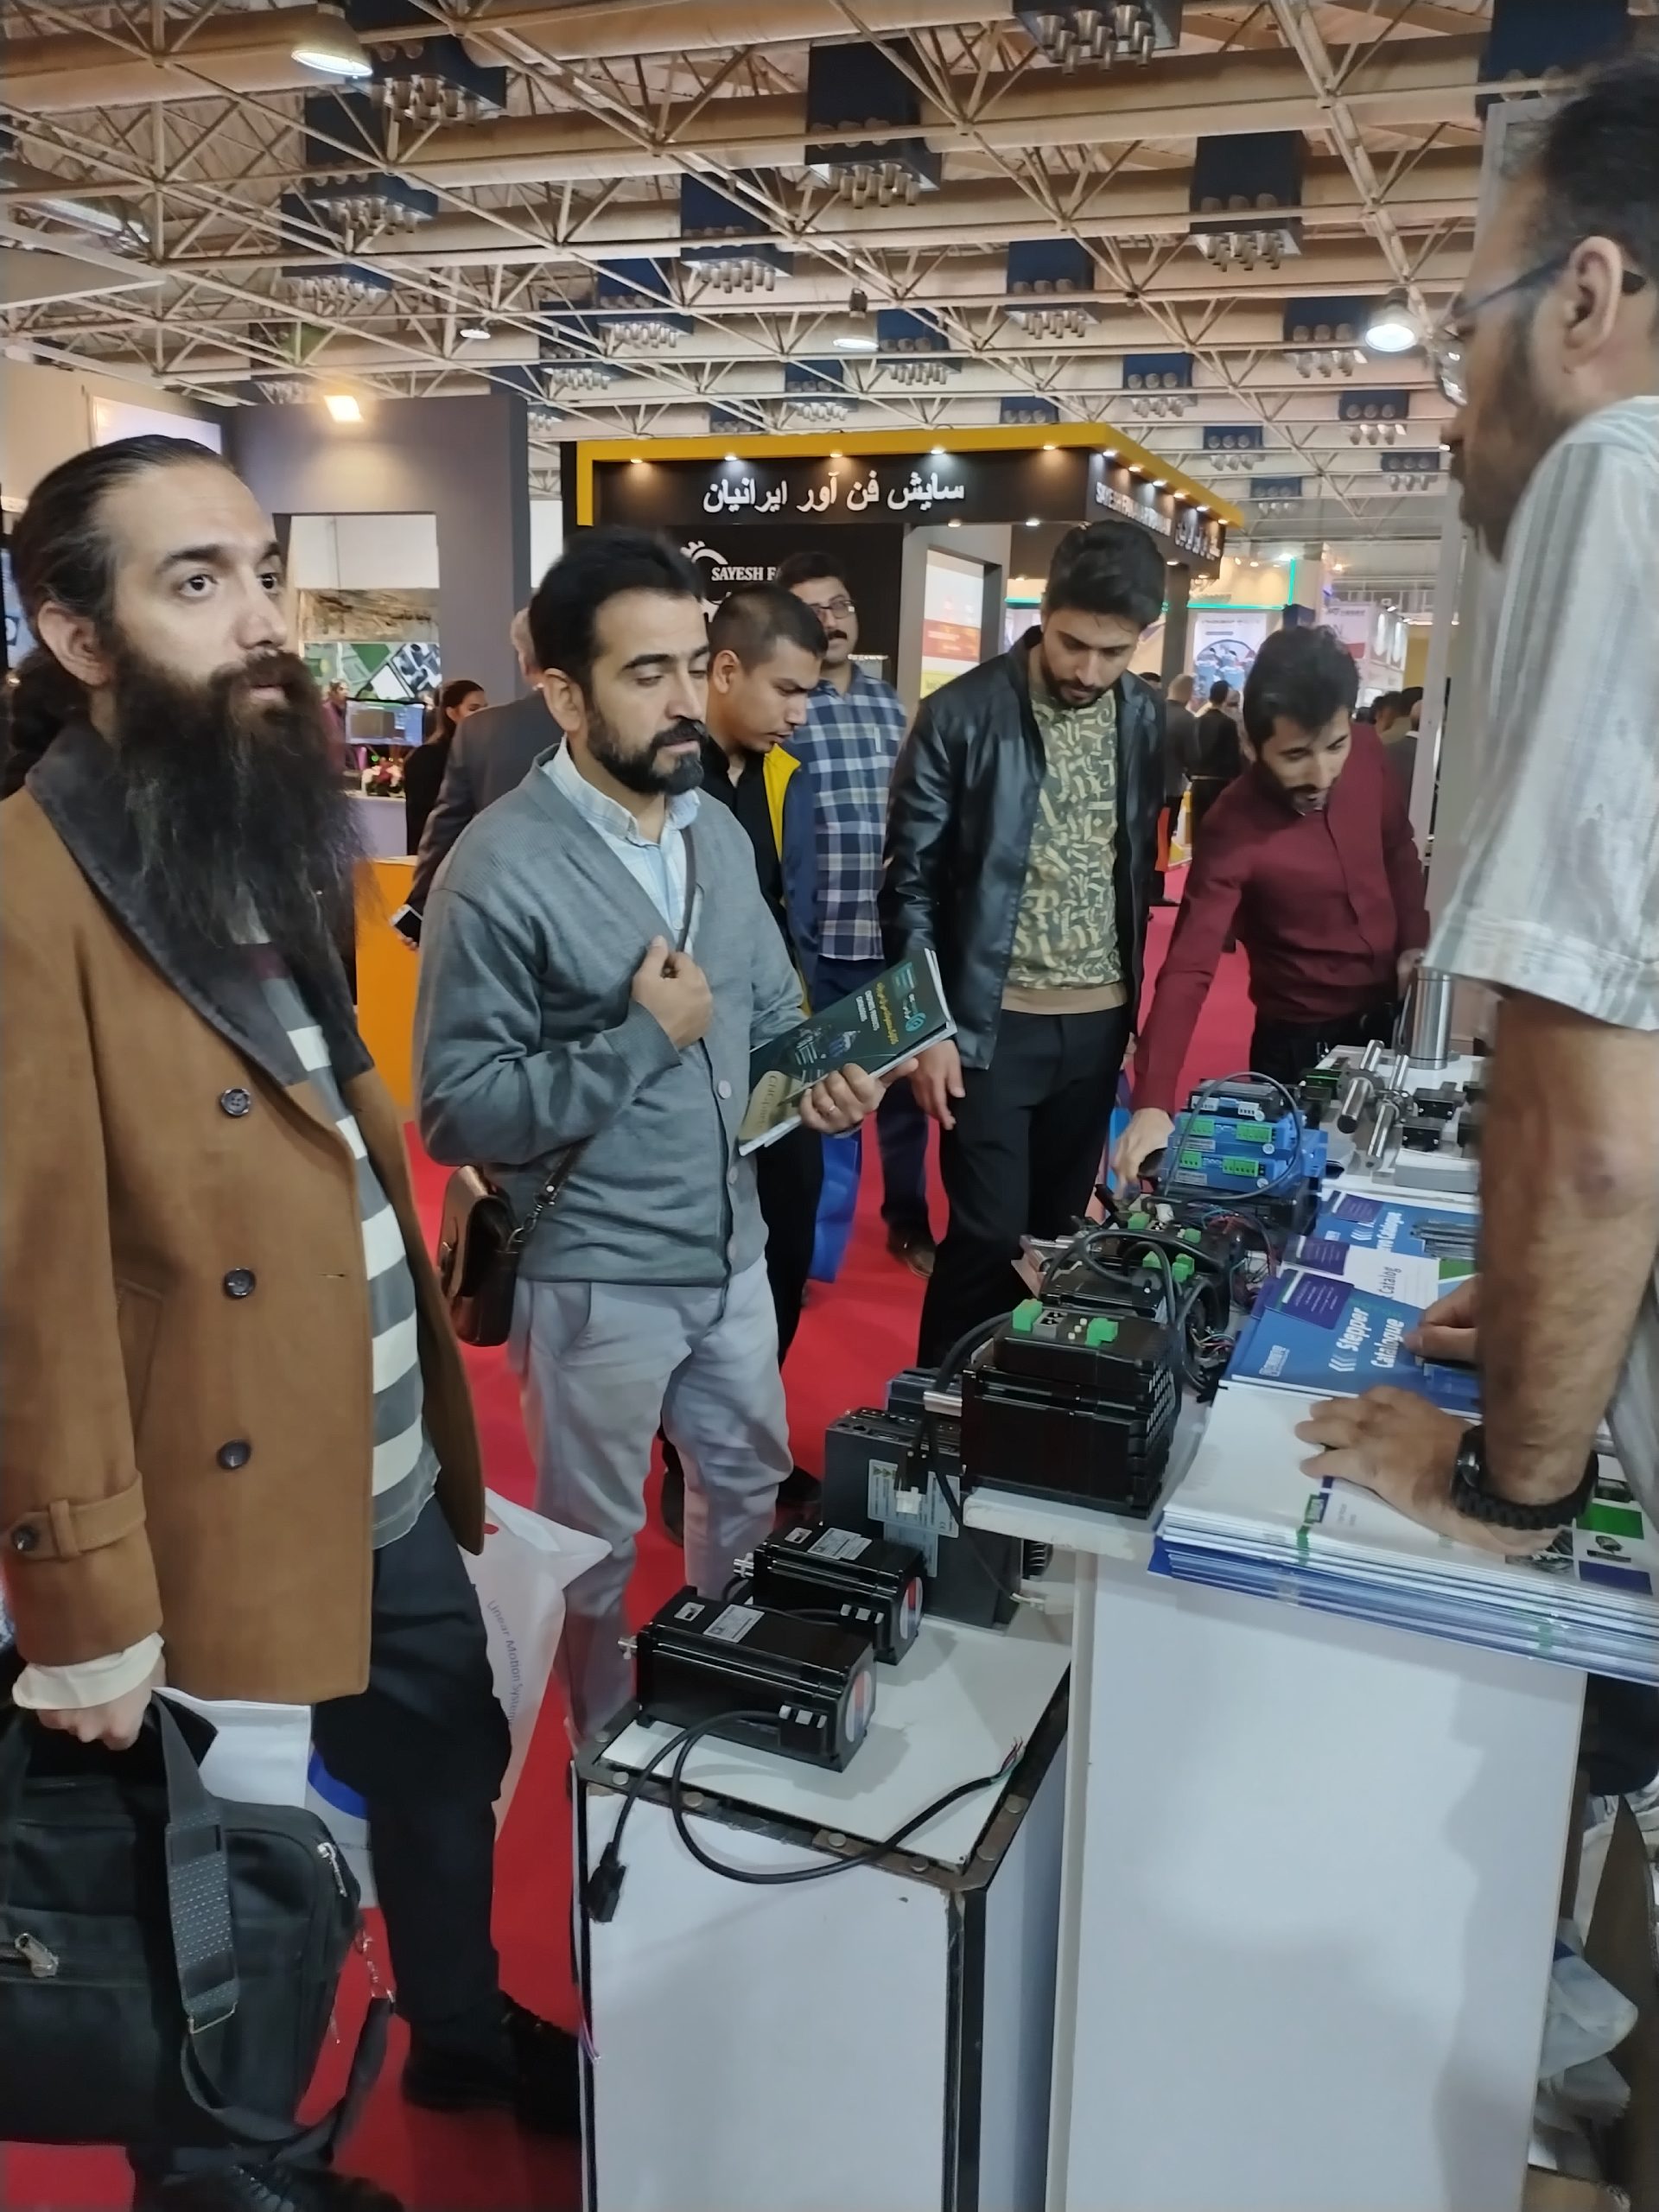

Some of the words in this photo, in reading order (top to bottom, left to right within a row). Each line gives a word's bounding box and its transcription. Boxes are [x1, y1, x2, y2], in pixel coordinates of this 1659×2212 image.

[702, 477, 788, 513] ایرانیان
[796, 471, 839, 512] آور
[846, 470, 880, 512] فن
[887, 471, 965, 512] سایش
[711, 566, 764, 582] SAYESH
[1378, 1266, 1402, 1295] Catalog
[1335, 1306, 1372, 1352] Stepper
[1370, 1318, 1406, 1369] Catalogue
[486, 1599, 511, 1637] Linear
[505, 1639, 520, 1682] Motion
